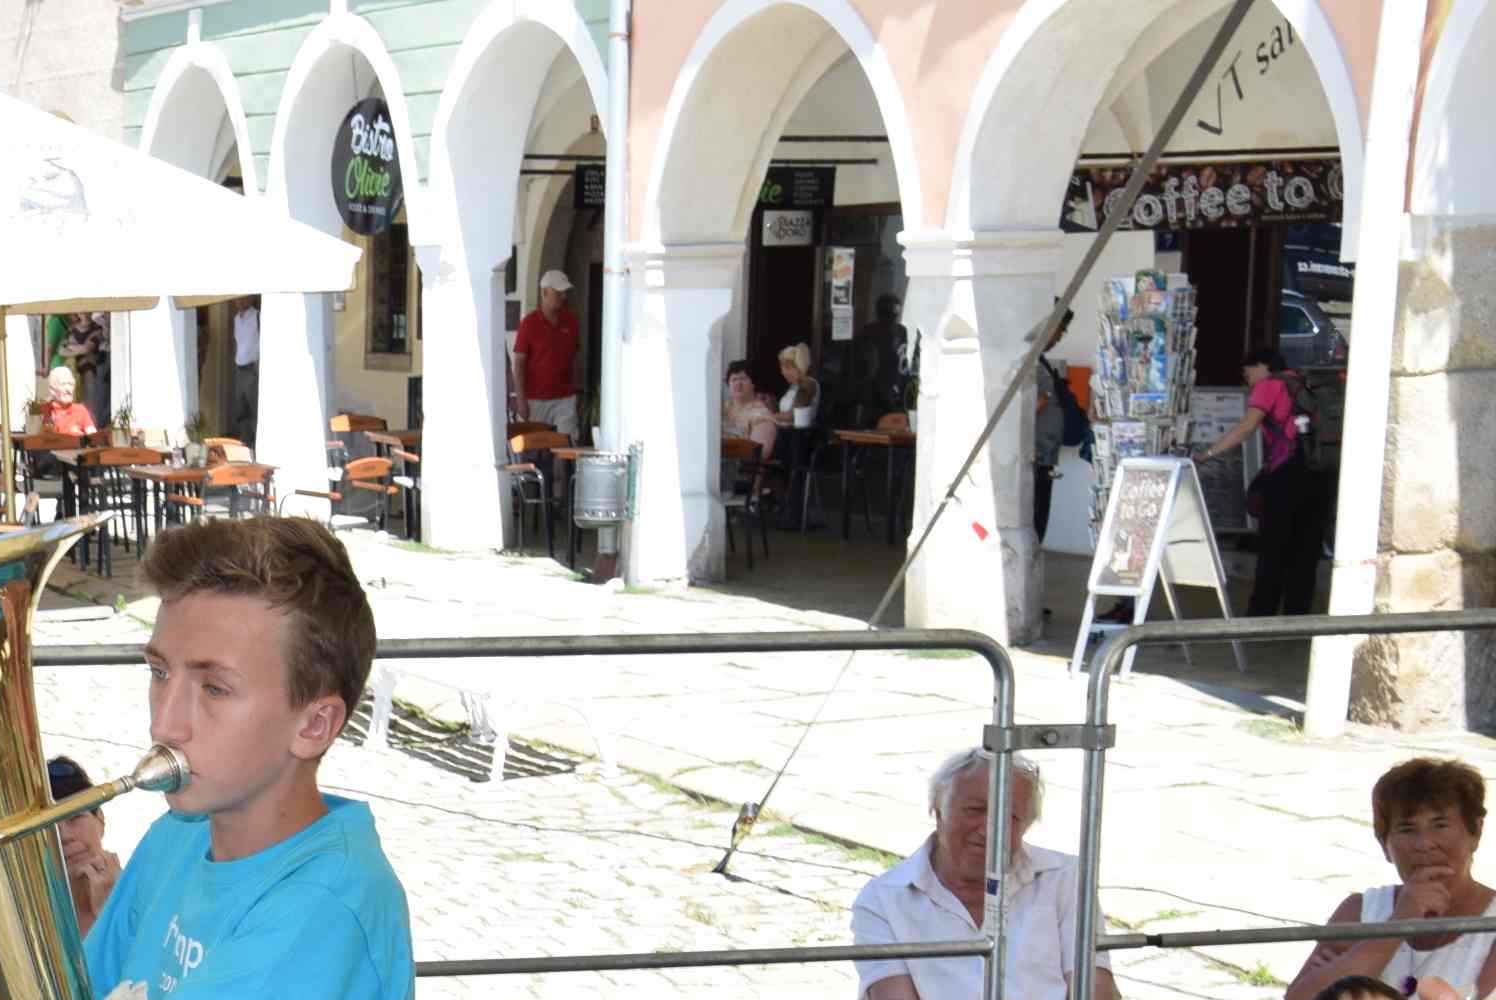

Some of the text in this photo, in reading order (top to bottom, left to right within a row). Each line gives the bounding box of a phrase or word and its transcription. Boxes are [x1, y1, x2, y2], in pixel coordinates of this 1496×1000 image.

[350, 113, 393, 161] Bistro
[1104, 174, 1251, 228] Coffee
[1264, 170, 1315, 211] to
